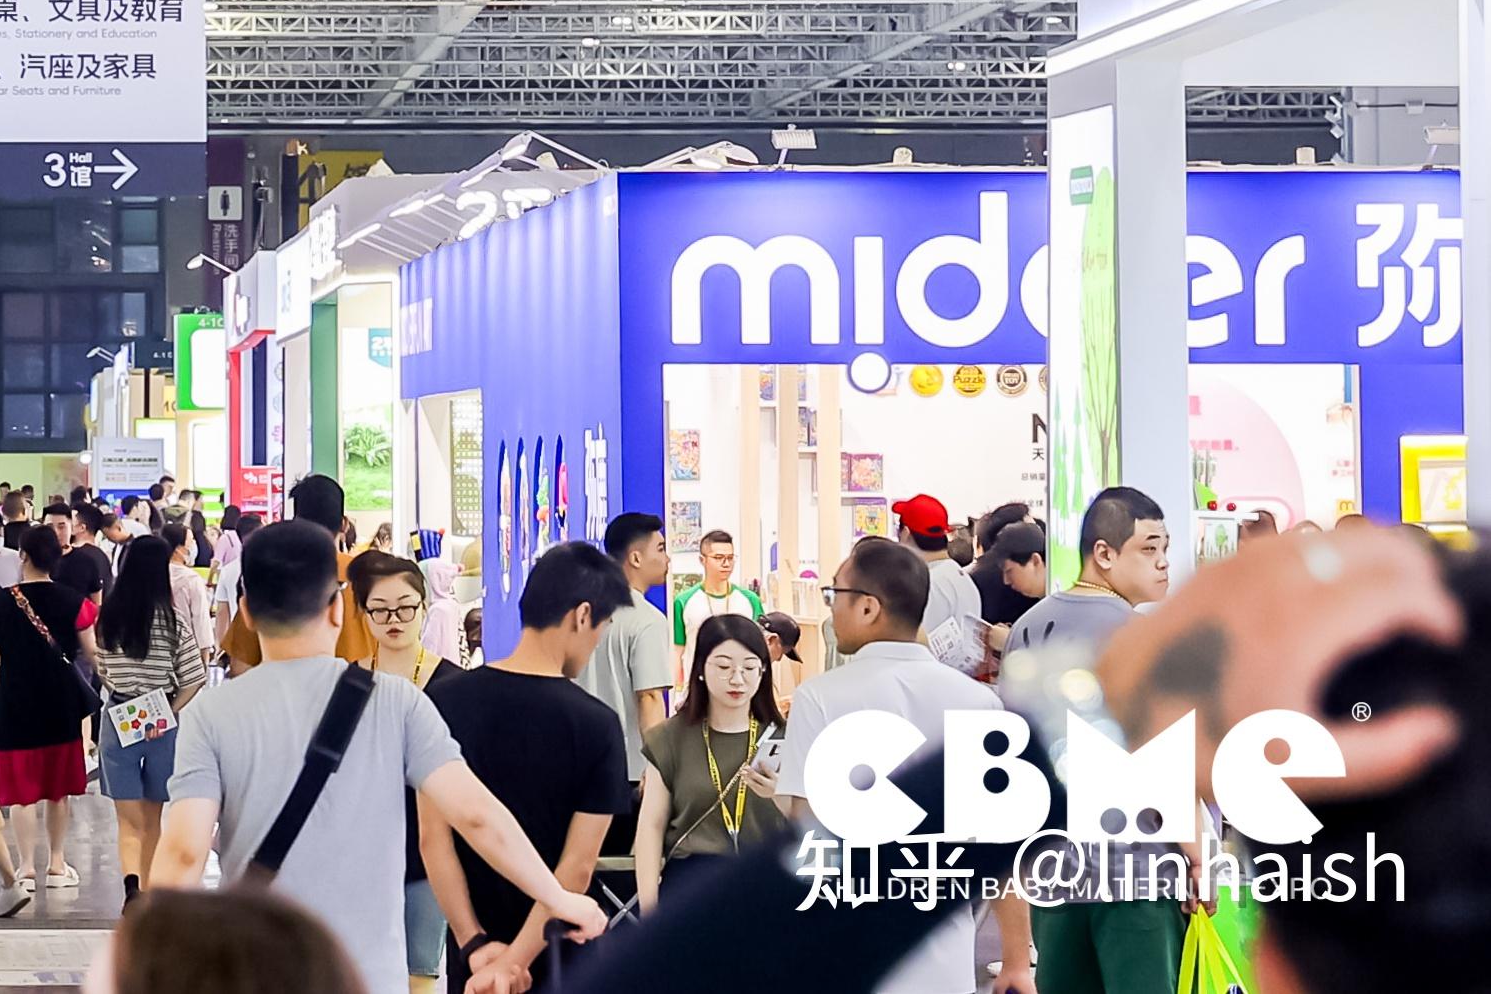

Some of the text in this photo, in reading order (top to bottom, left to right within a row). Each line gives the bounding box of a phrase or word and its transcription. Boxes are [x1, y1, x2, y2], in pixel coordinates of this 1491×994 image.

[15, 29, 72, 41] Stationery
[76, 29, 98, 39] and
[101, 29, 157, 39] Education
[12, 86, 44, 96] Seats
[48, 86, 69, 96] and
[73, 86, 121, 96] Furniture
[69, 153, 93, 164] Hall
[43, 153, 66, 187] 3
[69, 166, 92, 187] 馆
